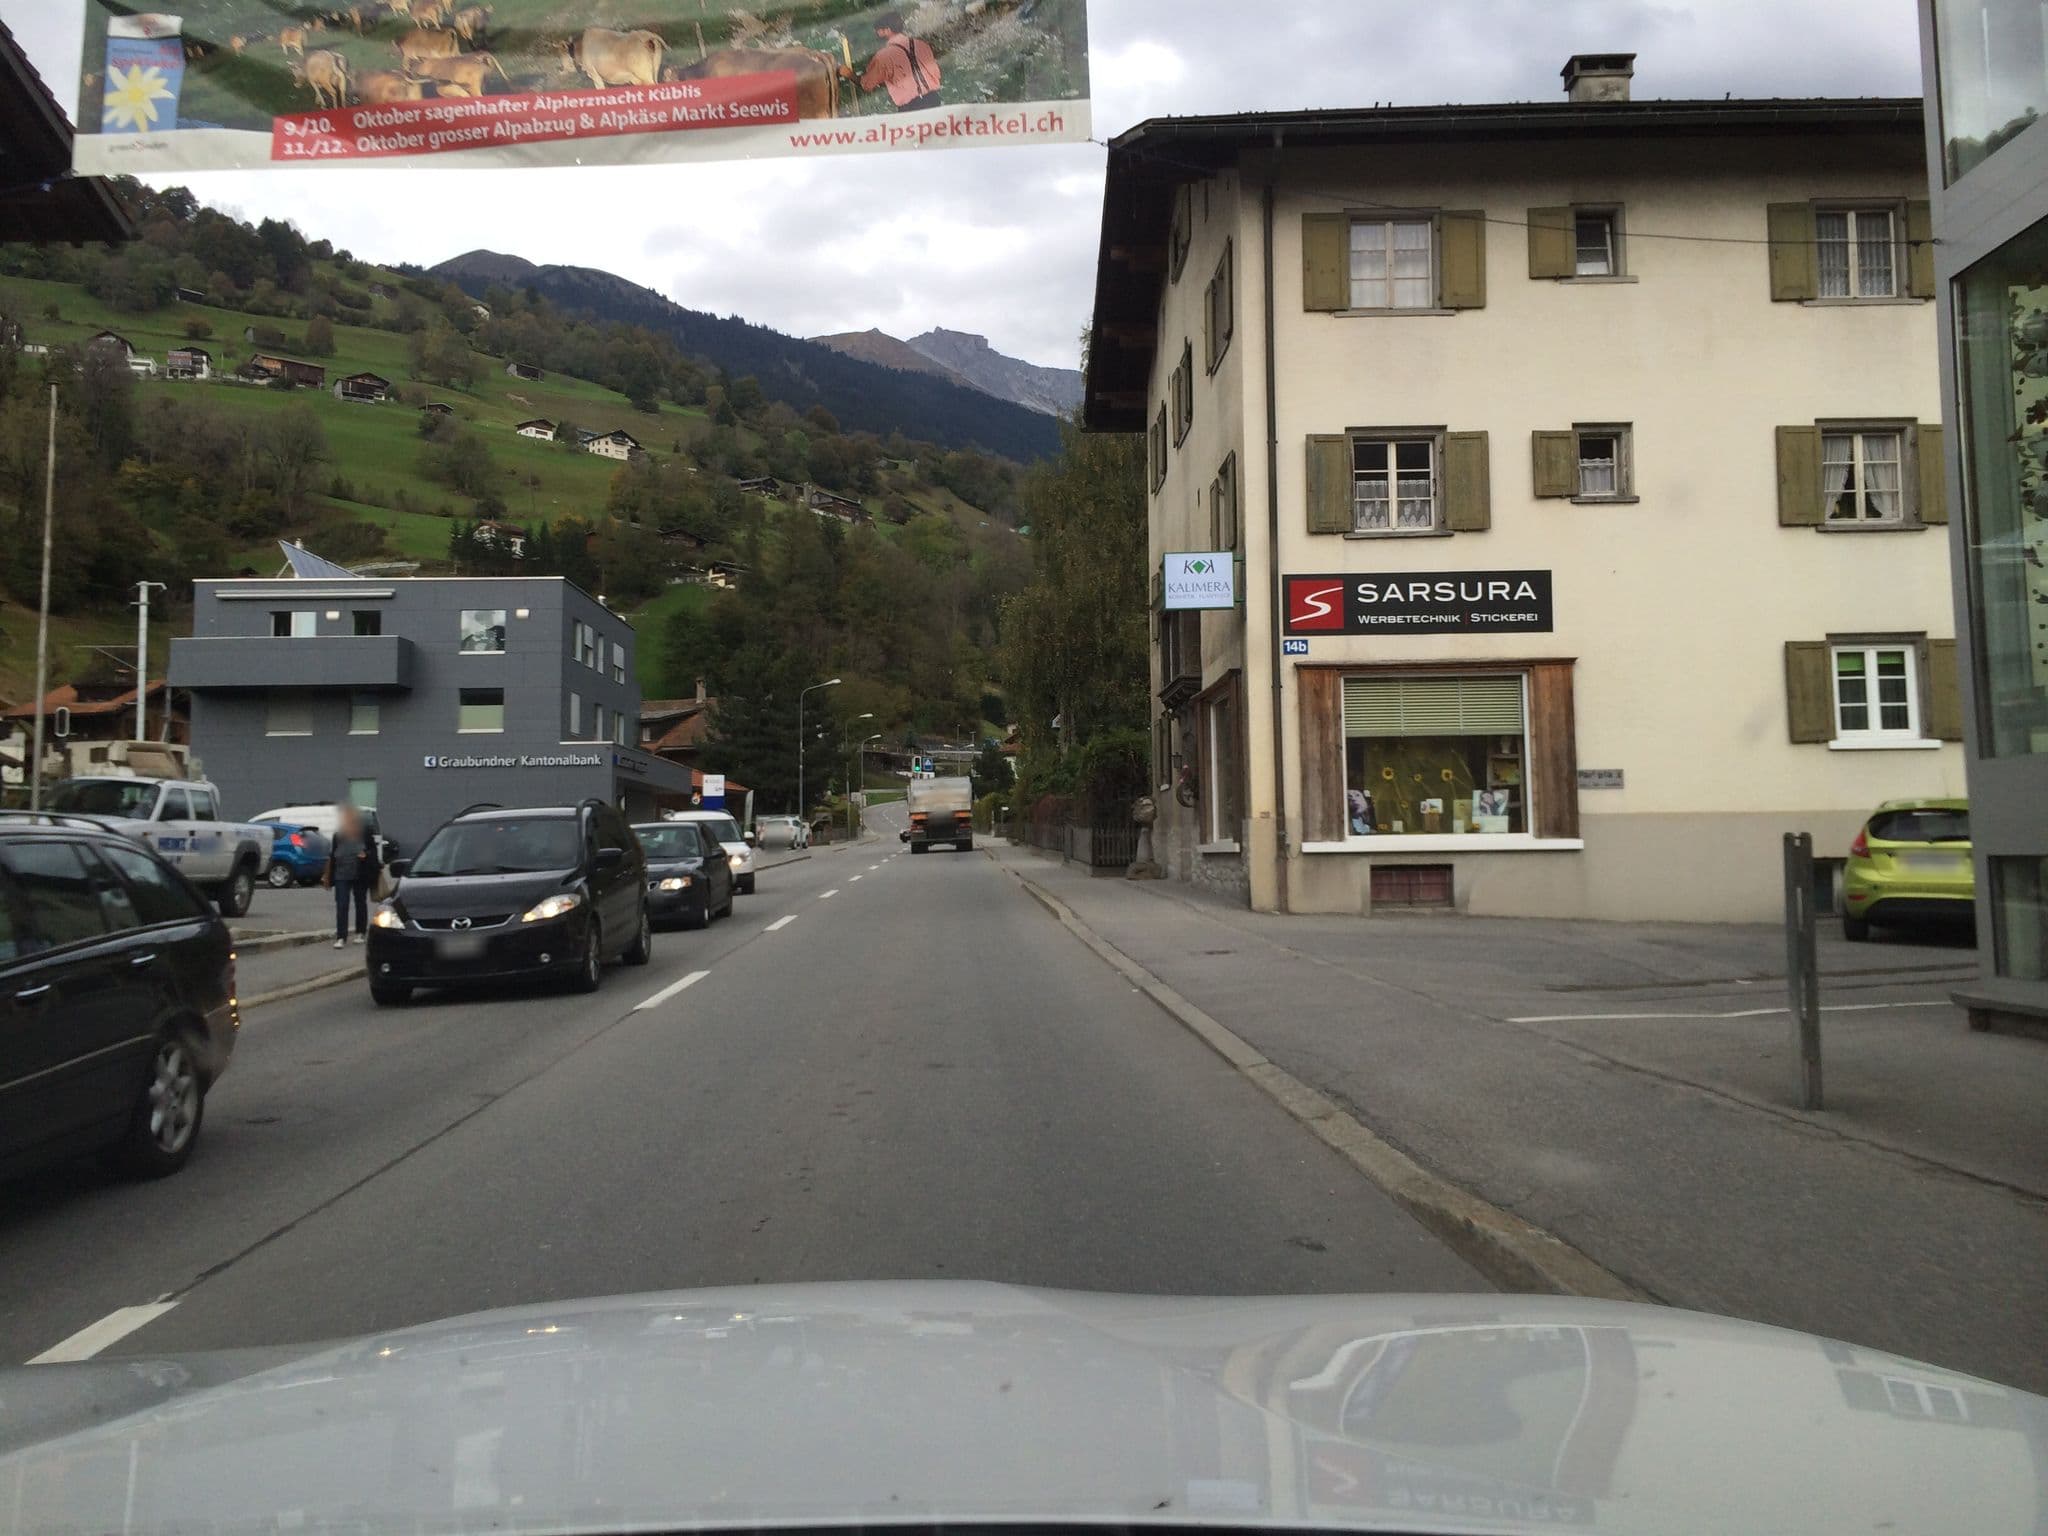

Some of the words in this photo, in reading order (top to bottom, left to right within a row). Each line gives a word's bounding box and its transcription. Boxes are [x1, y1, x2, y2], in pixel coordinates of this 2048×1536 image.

[353, 107, 421, 129] Oktober
[426, 99, 530, 123] sagenhafter
[649, 84, 702, 101] Küblis
[356, 131, 425, 153] Oktober
[429, 126, 490, 149] grosser
[493, 118, 575, 140] Alpabzug
[579, 112, 595, 130] &
[599, 109, 669, 131] Alpkäse
[672, 104, 727, 122] Markt
[728, 98, 790, 118] Seewis
[788, 111, 1065, 148] www.alpspektakel.ch
[1167, 581, 1231, 593] KALIMERA
[1357, 580, 1537, 603] SARSURA
[1357, 614, 1461, 624] WERBETECHNIK
[1470, 612, 1538, 623] STICKEREI
[1284, 640, 1307, 652] 14b
[520, 754, 602, 766] Kantonalbank
